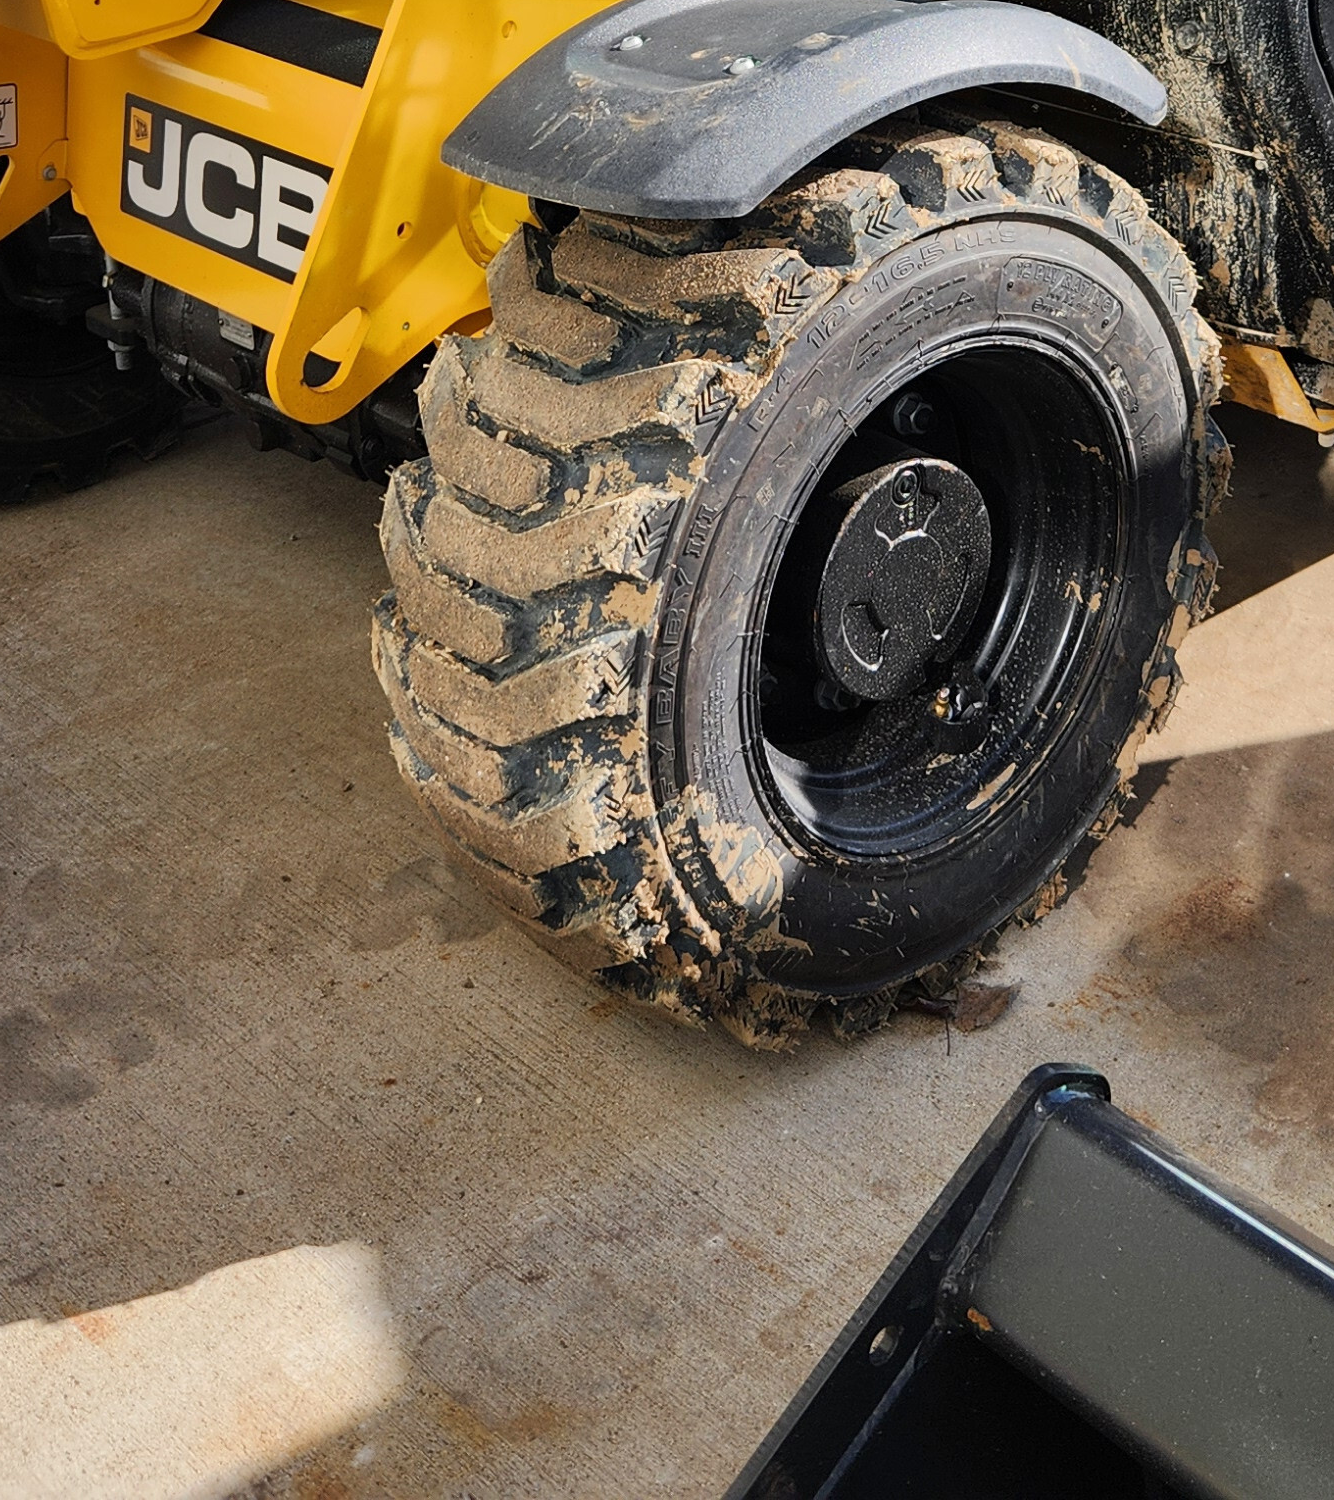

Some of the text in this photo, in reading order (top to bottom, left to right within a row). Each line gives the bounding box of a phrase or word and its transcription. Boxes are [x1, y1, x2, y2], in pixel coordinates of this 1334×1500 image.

[127, 118, 329, 274] JCB
[954, 226, 1017, 252] NHS
[656, 566, 694, 725] BABY
[682, 502, 719, 559] III
